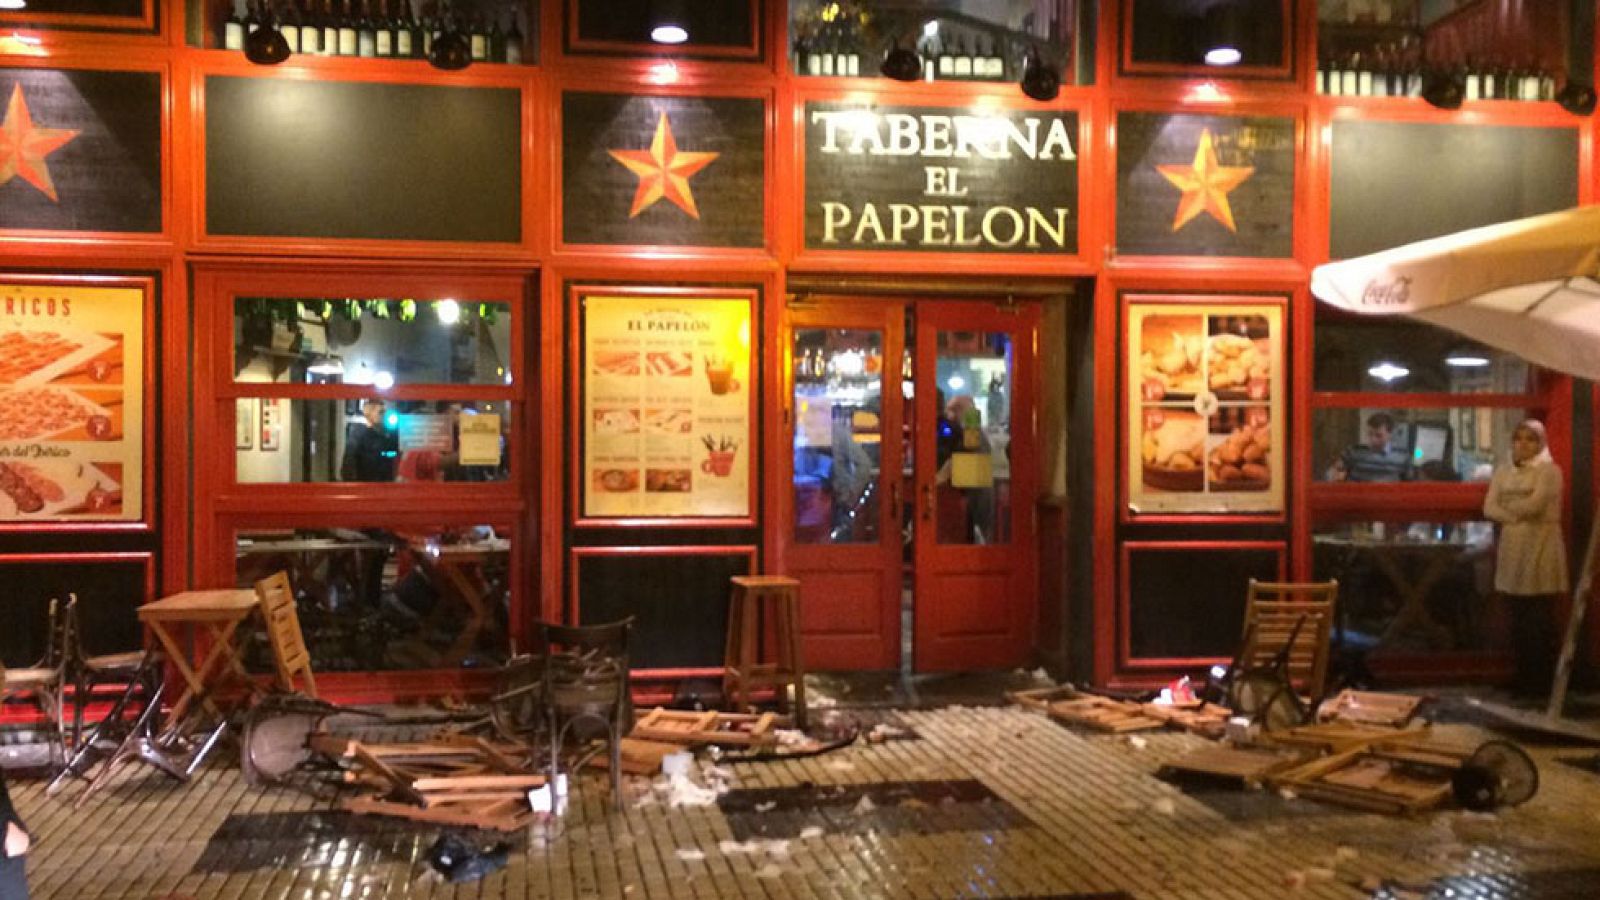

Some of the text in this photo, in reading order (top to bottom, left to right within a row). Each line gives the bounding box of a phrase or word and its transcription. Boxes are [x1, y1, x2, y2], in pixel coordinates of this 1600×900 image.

[812, 110, 1077, 160] TABERNA
[923, 166, 968, 196] EL
[821, 202, 1069, 248] PAPELON
[627, 320, 643, 332] EL
